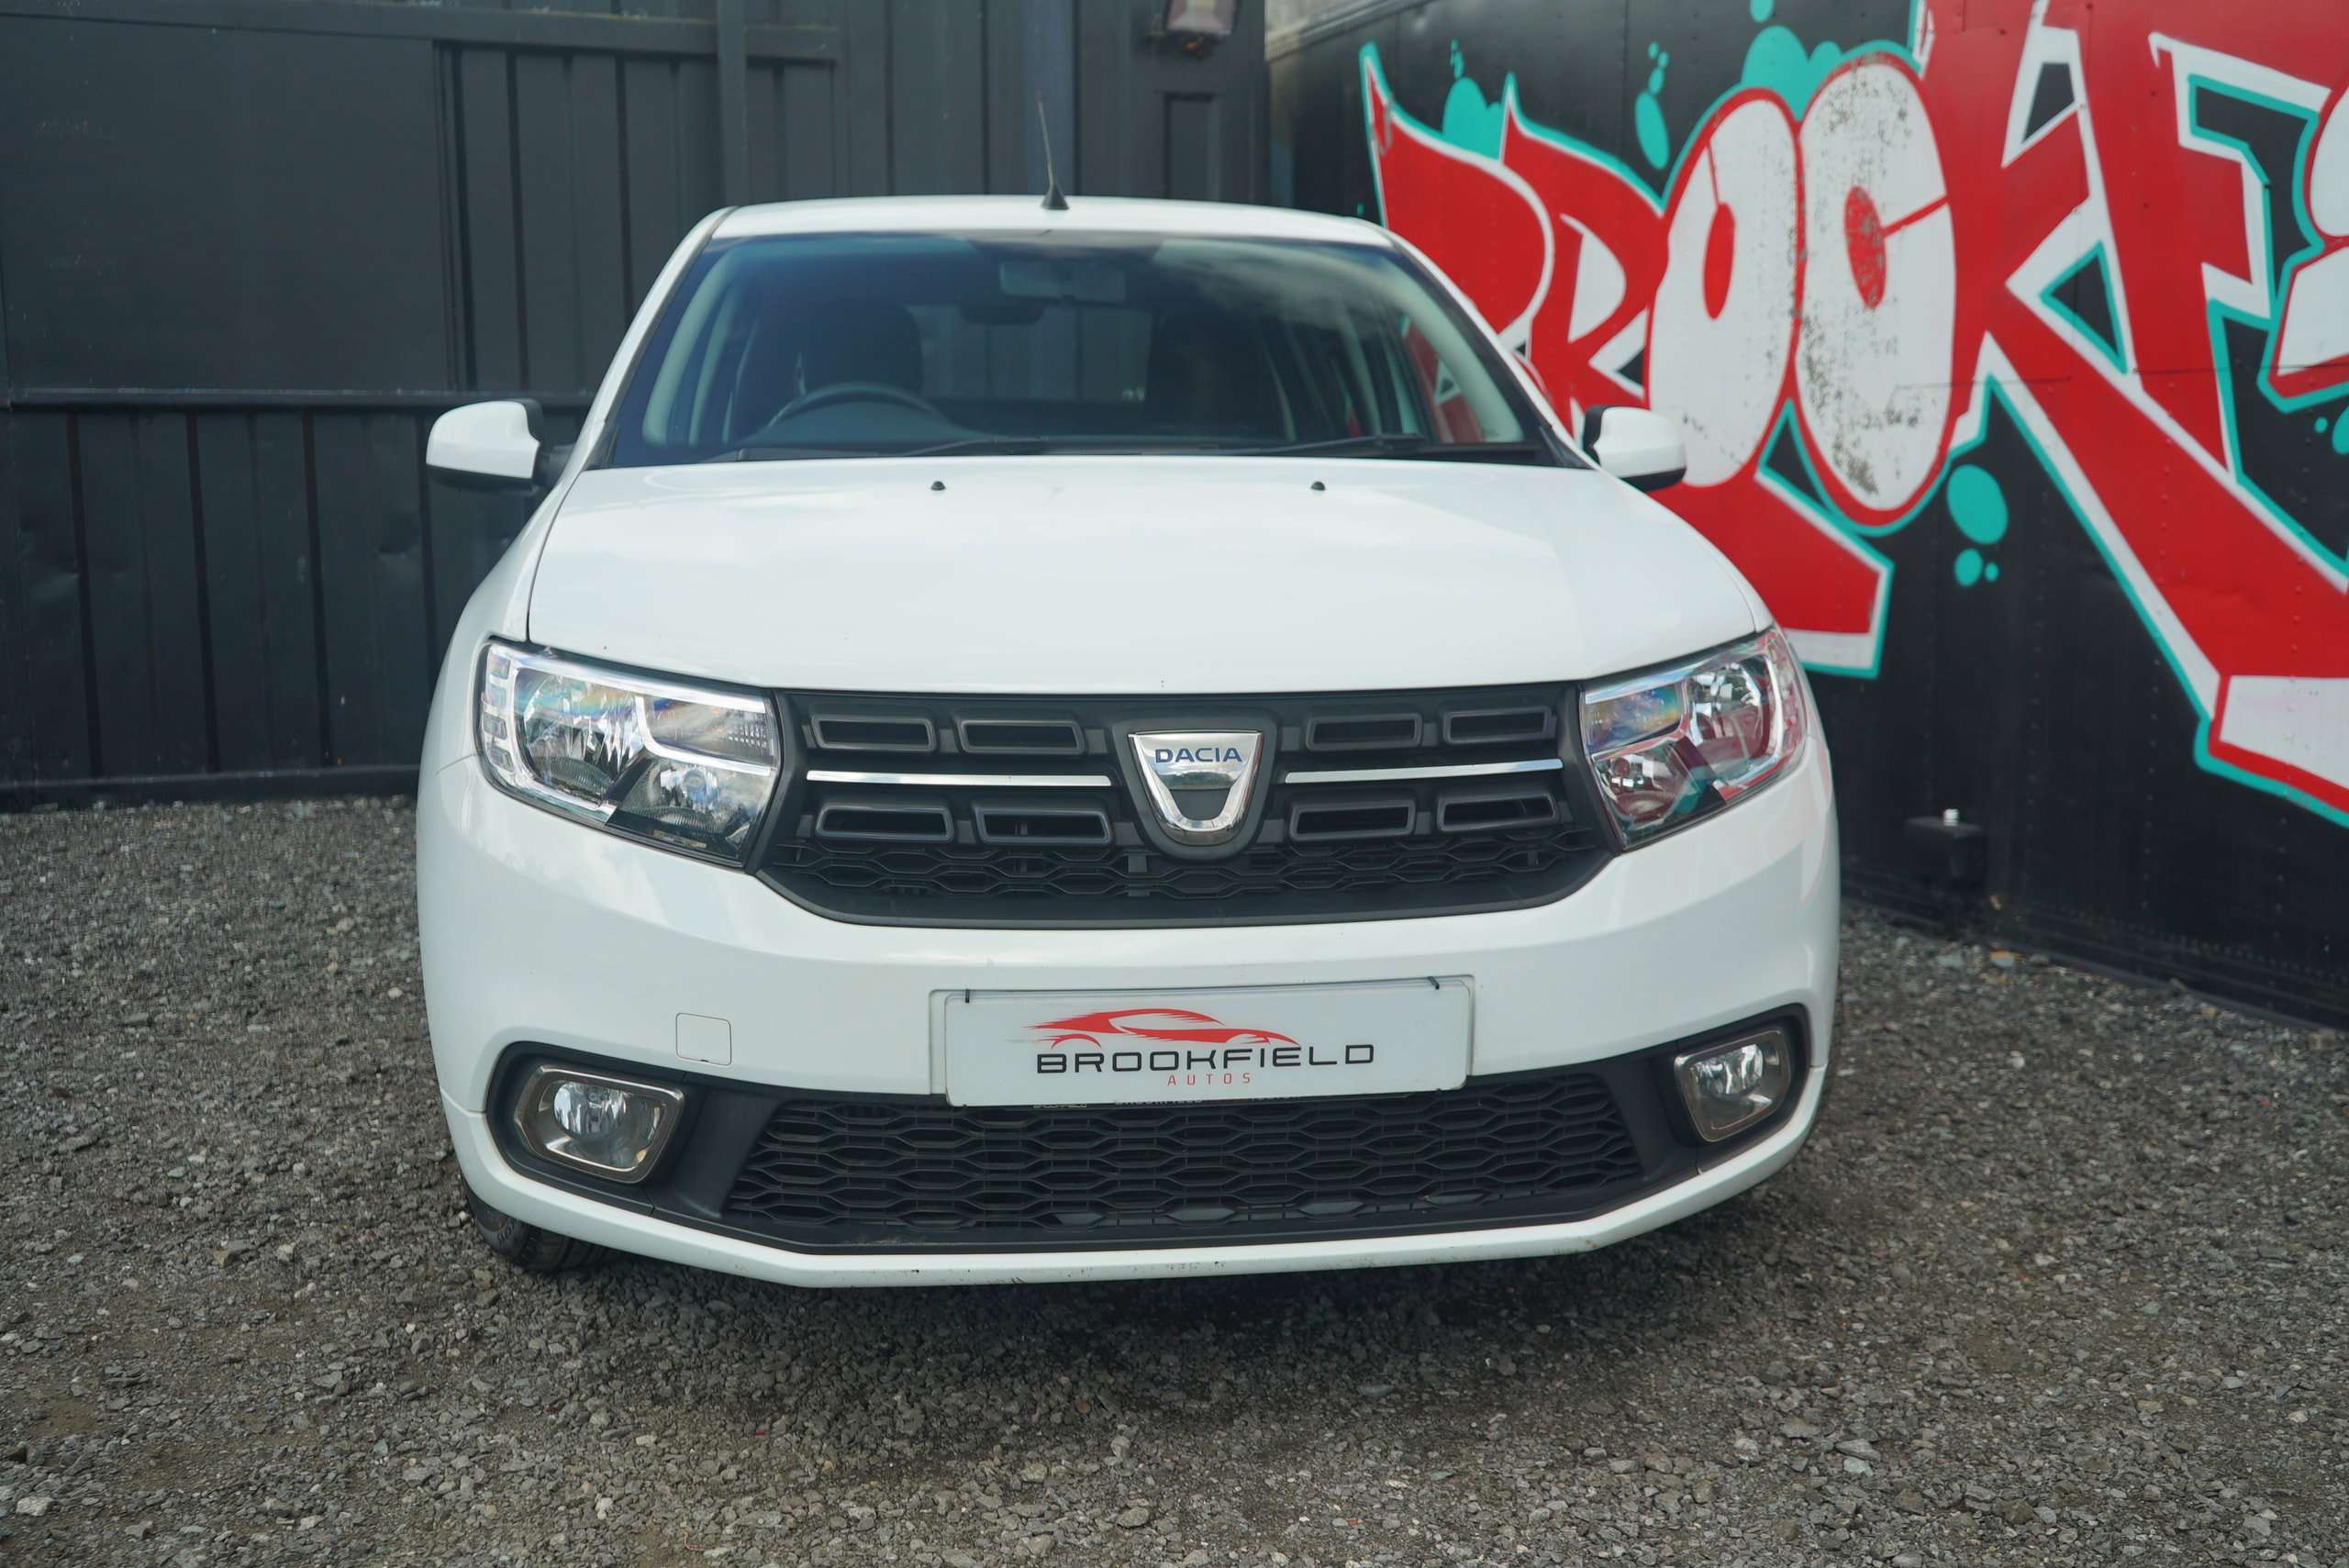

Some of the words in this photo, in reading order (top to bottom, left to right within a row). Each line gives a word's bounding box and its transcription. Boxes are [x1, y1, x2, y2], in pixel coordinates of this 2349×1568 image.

[1155, 748, 1242, 763] DACIA
[1037, 1044, 1375, 1073] BROOKFIELD
[1167, 1072, 1251, 1086] AUTOS
